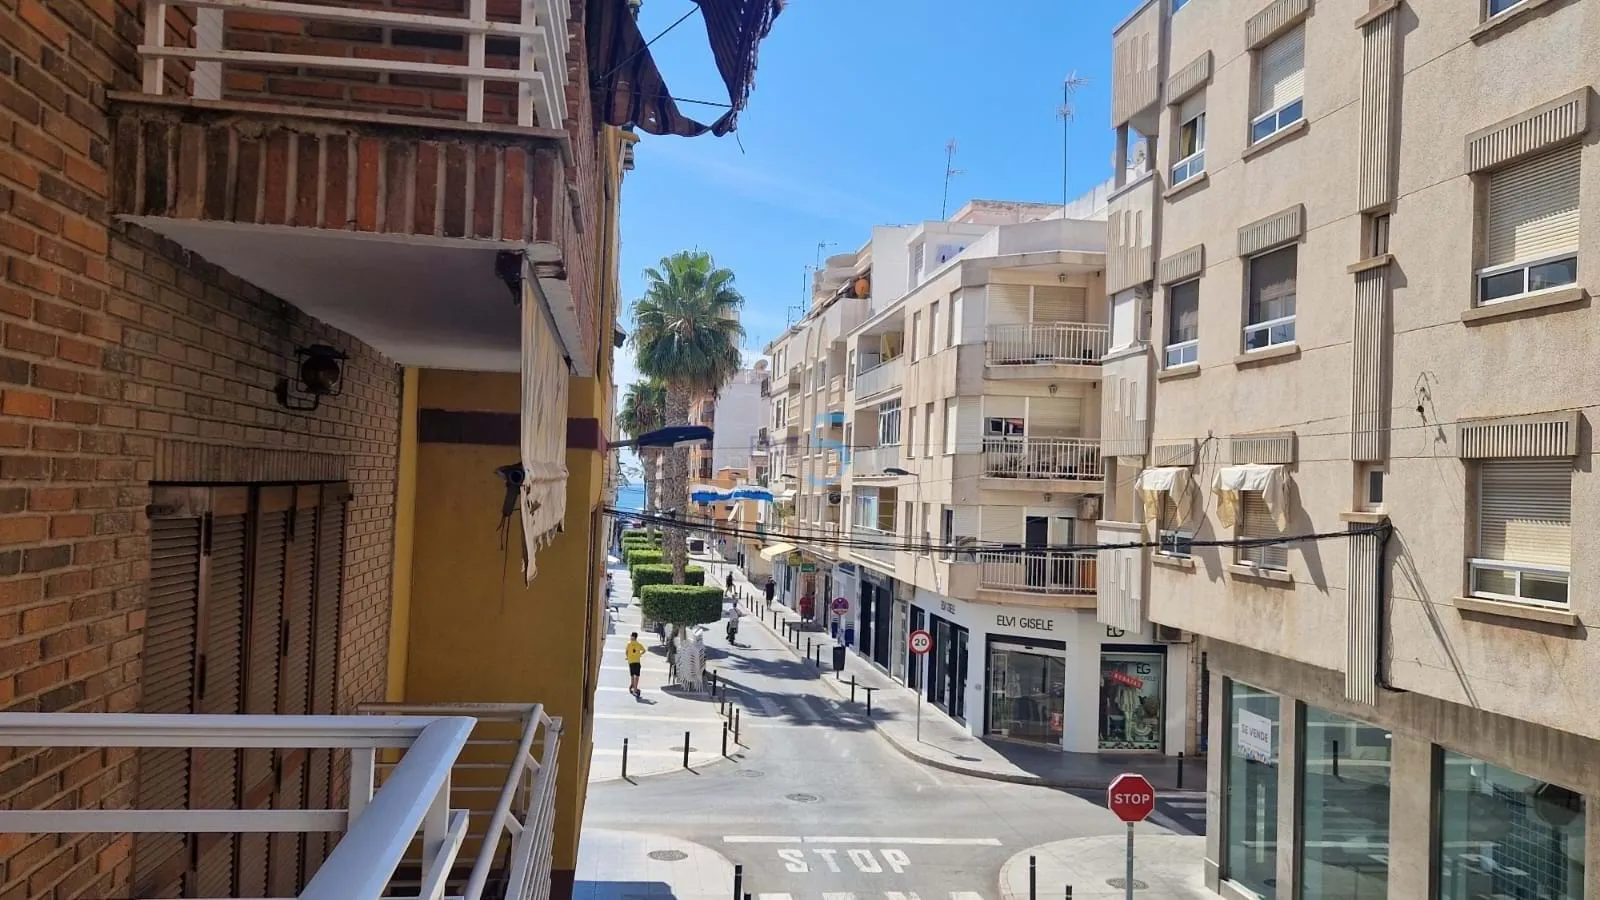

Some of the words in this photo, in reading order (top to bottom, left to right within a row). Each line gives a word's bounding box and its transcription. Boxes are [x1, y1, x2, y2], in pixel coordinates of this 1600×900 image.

[996, 614, 1016, 628] ELVI
[1019, 617, 1054, 632] GISELE
[1106, 625, 1125, 638] EG
[914, 638, 928, 647] 20
[1136, 662, 1151, 674] EG
[1241, 723, 1249, 735] SE
[1249, 727, 1269, 743] VENDE
[1114, 793, 1150, 805] STOP
[777, 848, 912, 873] STOP
